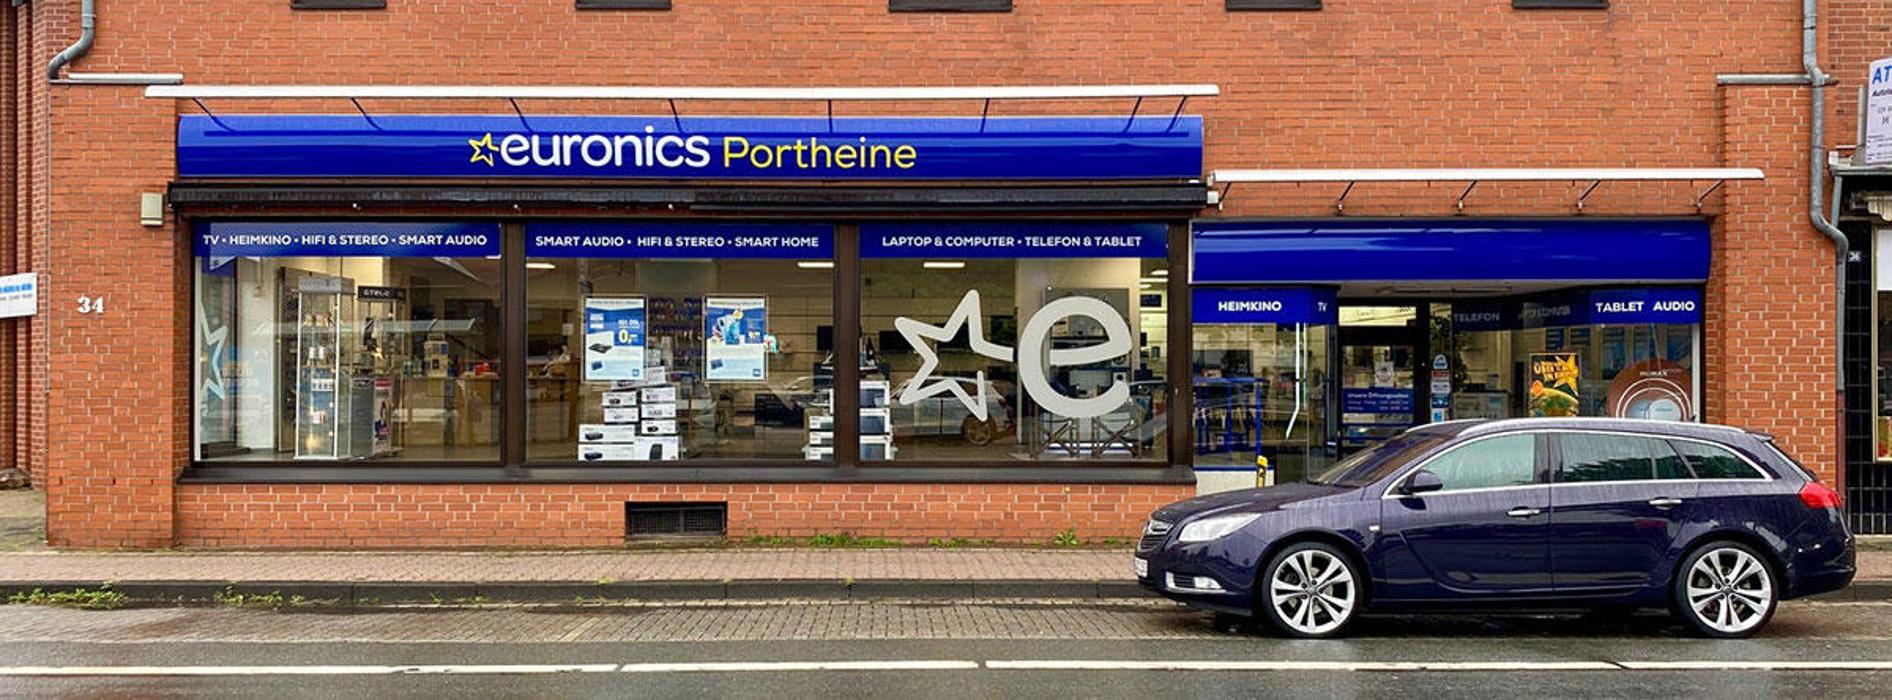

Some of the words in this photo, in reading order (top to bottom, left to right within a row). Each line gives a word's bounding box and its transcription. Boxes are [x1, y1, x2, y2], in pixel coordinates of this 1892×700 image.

[500, 125, 710, 168] euronics
[723, 136, 917, 169] Portheine
[203, 234, 220, 245] TV
[229, 234, 292, 245] HEIMKINO
[302, 234, 326, 245] HIFI
[328, 234, 337, 245] &
[339, 234, 389, 245] STEREO
[398, 234, 443, 246] SMART
[445, 234, 487, 246] AUDIO
[535, 236, 580, 247] SMART
[582, 236, 625, 247] AUDIO
[637, 236, 662, 247] HIFI
[664, 236, 673, 247] &
[675, 236, 725, 247] STEREO
[735, 236, 778, 247] SMART
[781, 236, 819, 247] HOME
[882, 236, 933, 247] LAPTOP
[934, 236, 943, 247] &
[945, 236, 1015, 247] COMPUTER
[1024, 236, 1081, 247] TELEFON
[1083, 236, 1092, 247] &
[1094, 236, 1142, 247] TABLET
[77, 295, 104, 314] 34
[1218, 300, 1282, 312] HEIMKINO
[1318, 302, 1327, 311] TV
[1595, 301, 1644, 313] TABLET
[1653, 300, 1696, 312] AUDIO
[1453, 312, 1500, 323] TELEFON
